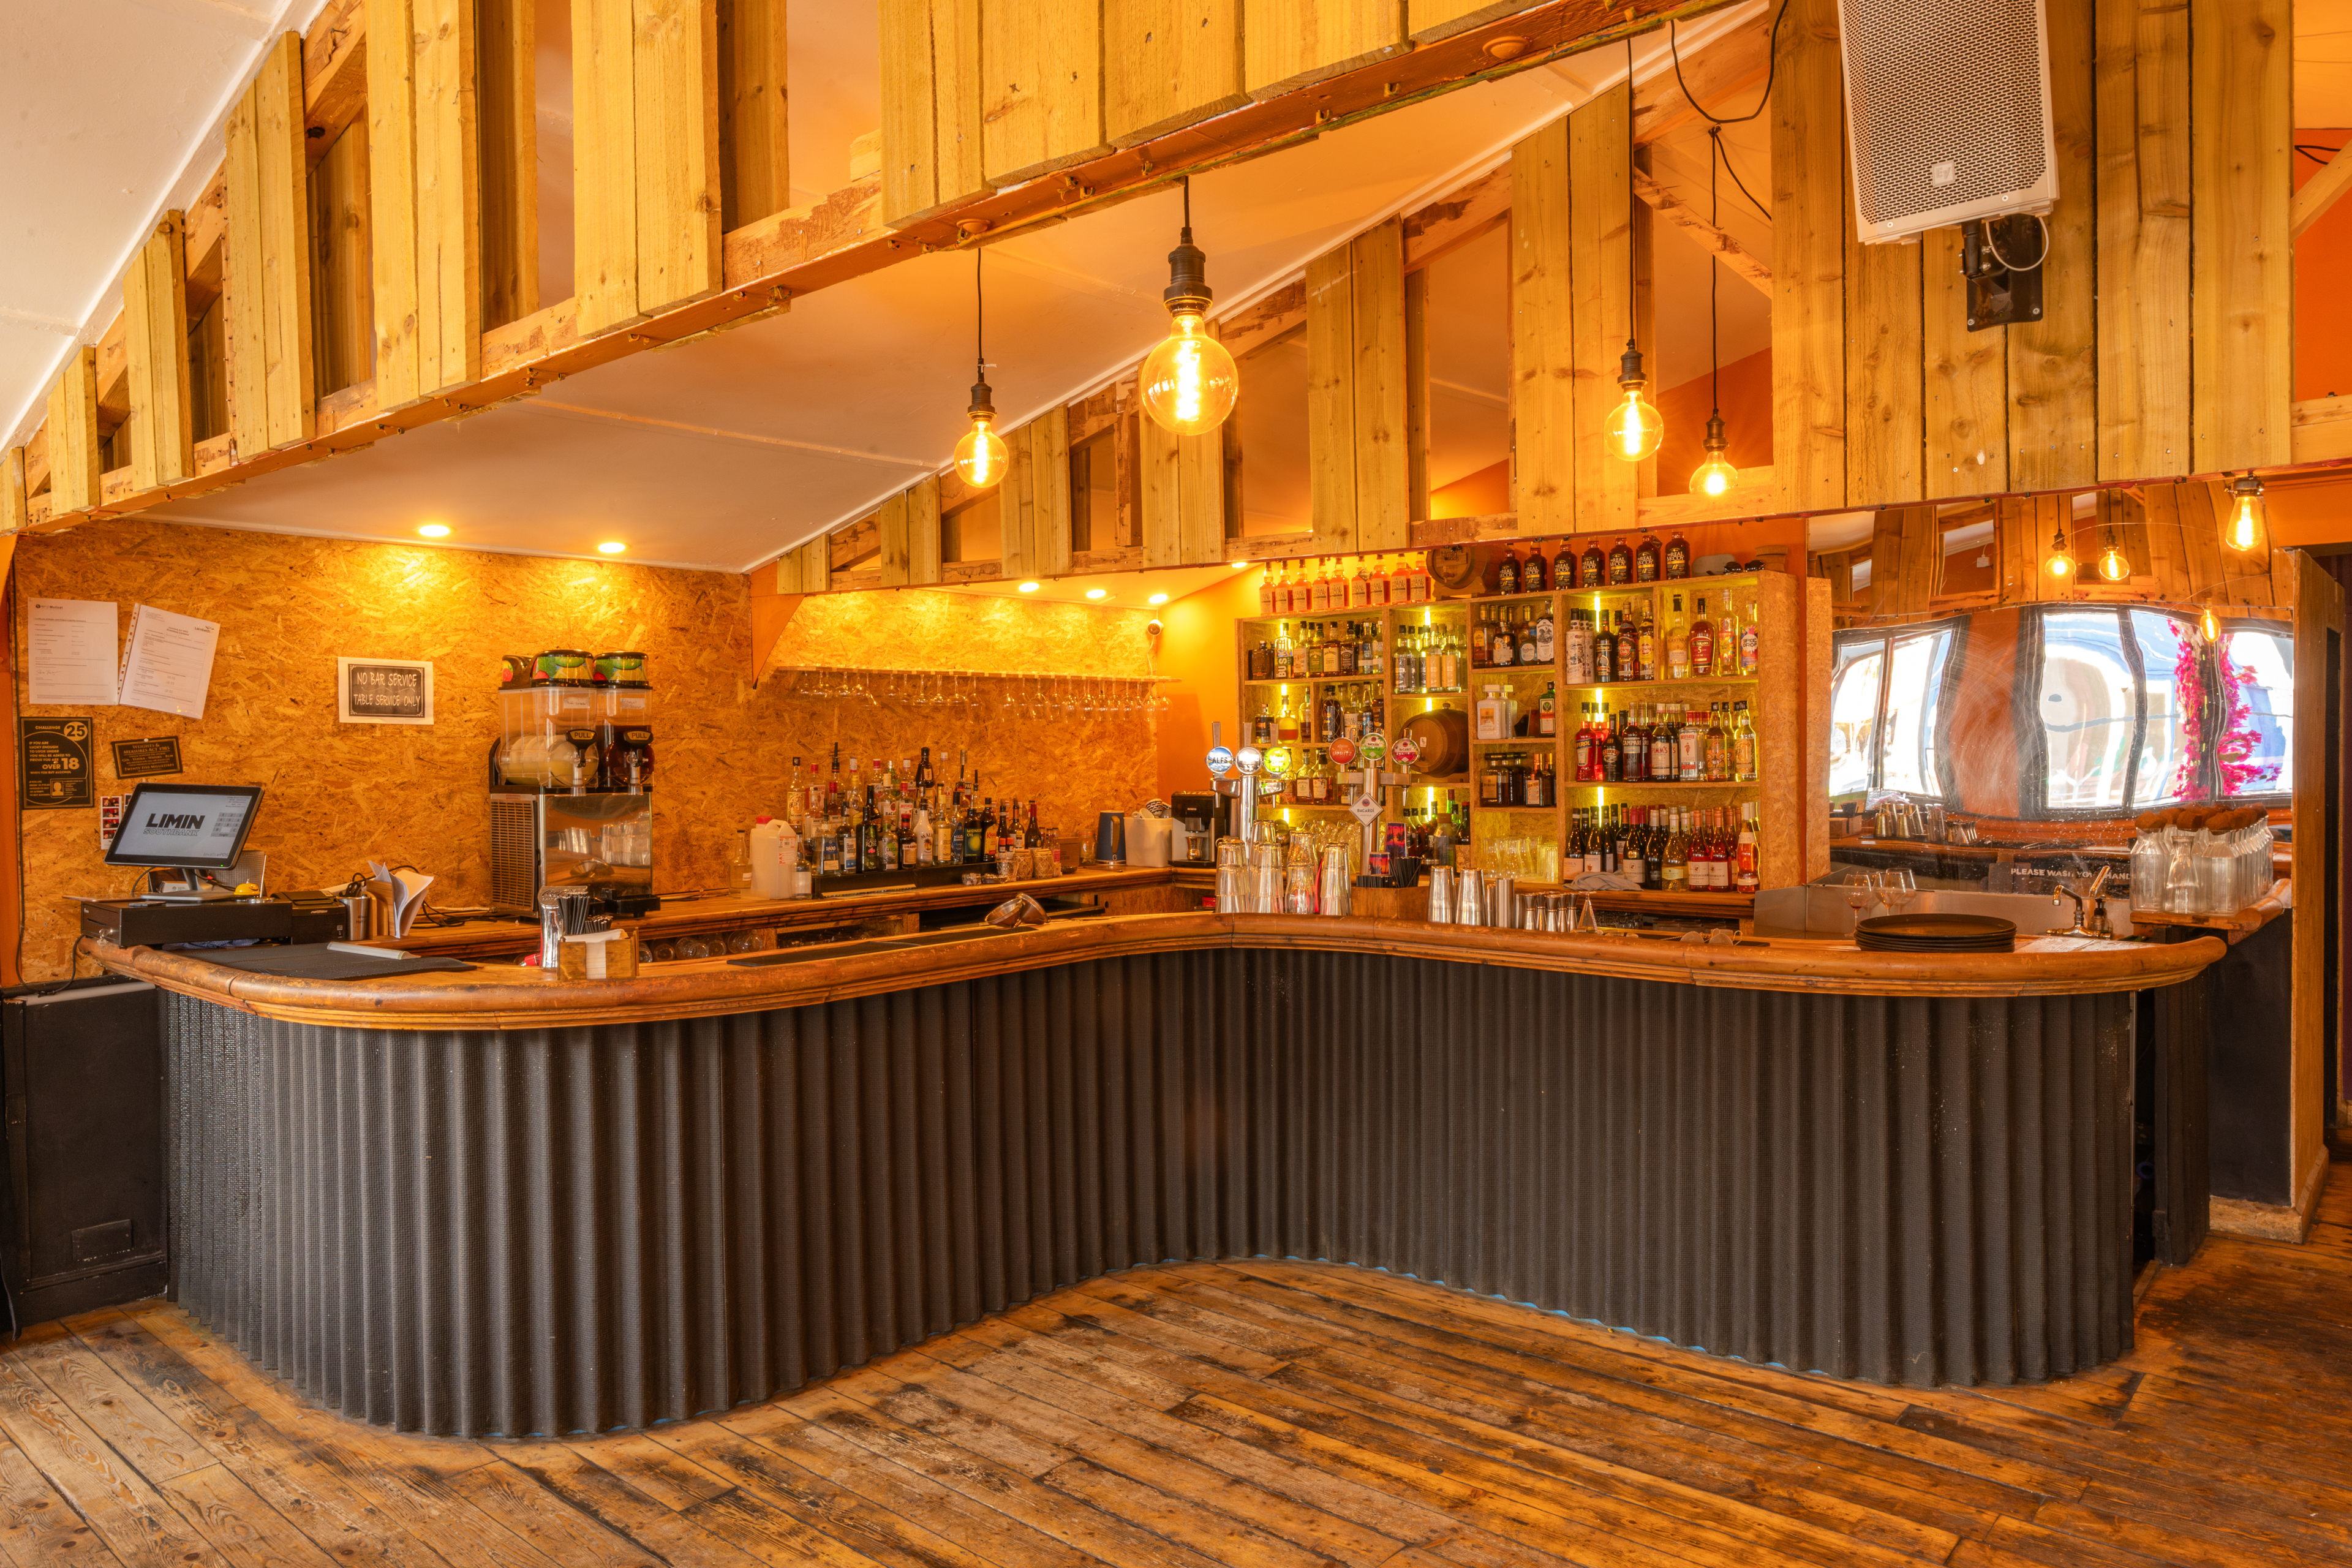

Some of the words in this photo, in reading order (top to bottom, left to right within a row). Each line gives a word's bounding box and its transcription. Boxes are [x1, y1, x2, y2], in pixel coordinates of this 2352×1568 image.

[1936, 167, 1951, 180] EV
[357, 672, 368, 685] NO
[370, 672, 385, 686] BAR
[388, 673, 417, 687] SERVICE
[353, 693, 373, 706] TABLE
[375, 695, 400, 706] SERVICE
[404, 696, 421, 712] ONLY
[66, 725, 86, 737] 25
[61, 757, 80, 770] 18
[146, 813, 206, 829] LIMIN
[143, 828, 200, 837] SOUTHBANK
[2010, 868, 2046, 876] PLEASE
